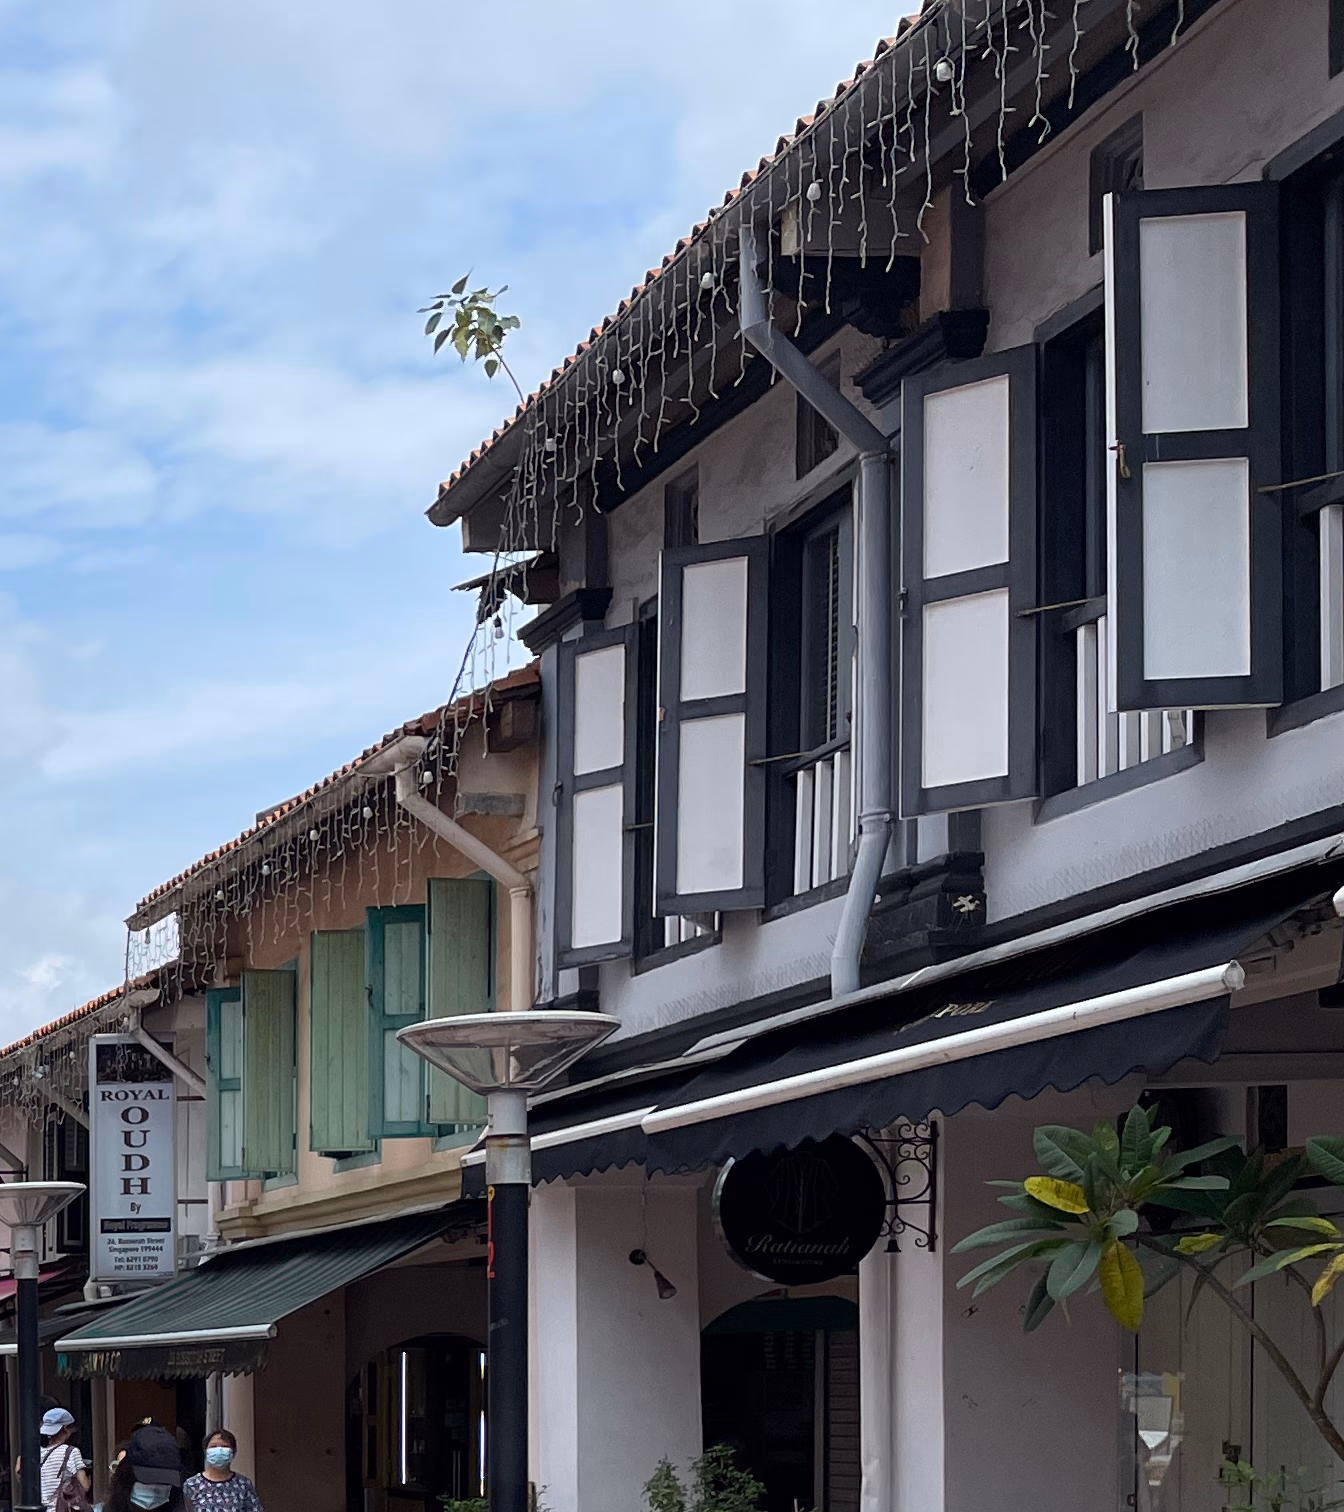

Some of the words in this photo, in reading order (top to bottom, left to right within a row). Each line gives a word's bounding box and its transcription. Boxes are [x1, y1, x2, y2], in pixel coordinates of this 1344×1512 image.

[100, 1089, 170, 1102] ROYAL
[119, 1106, 152, 1196] OUDH
[130, 1201, 142, 1215] By
